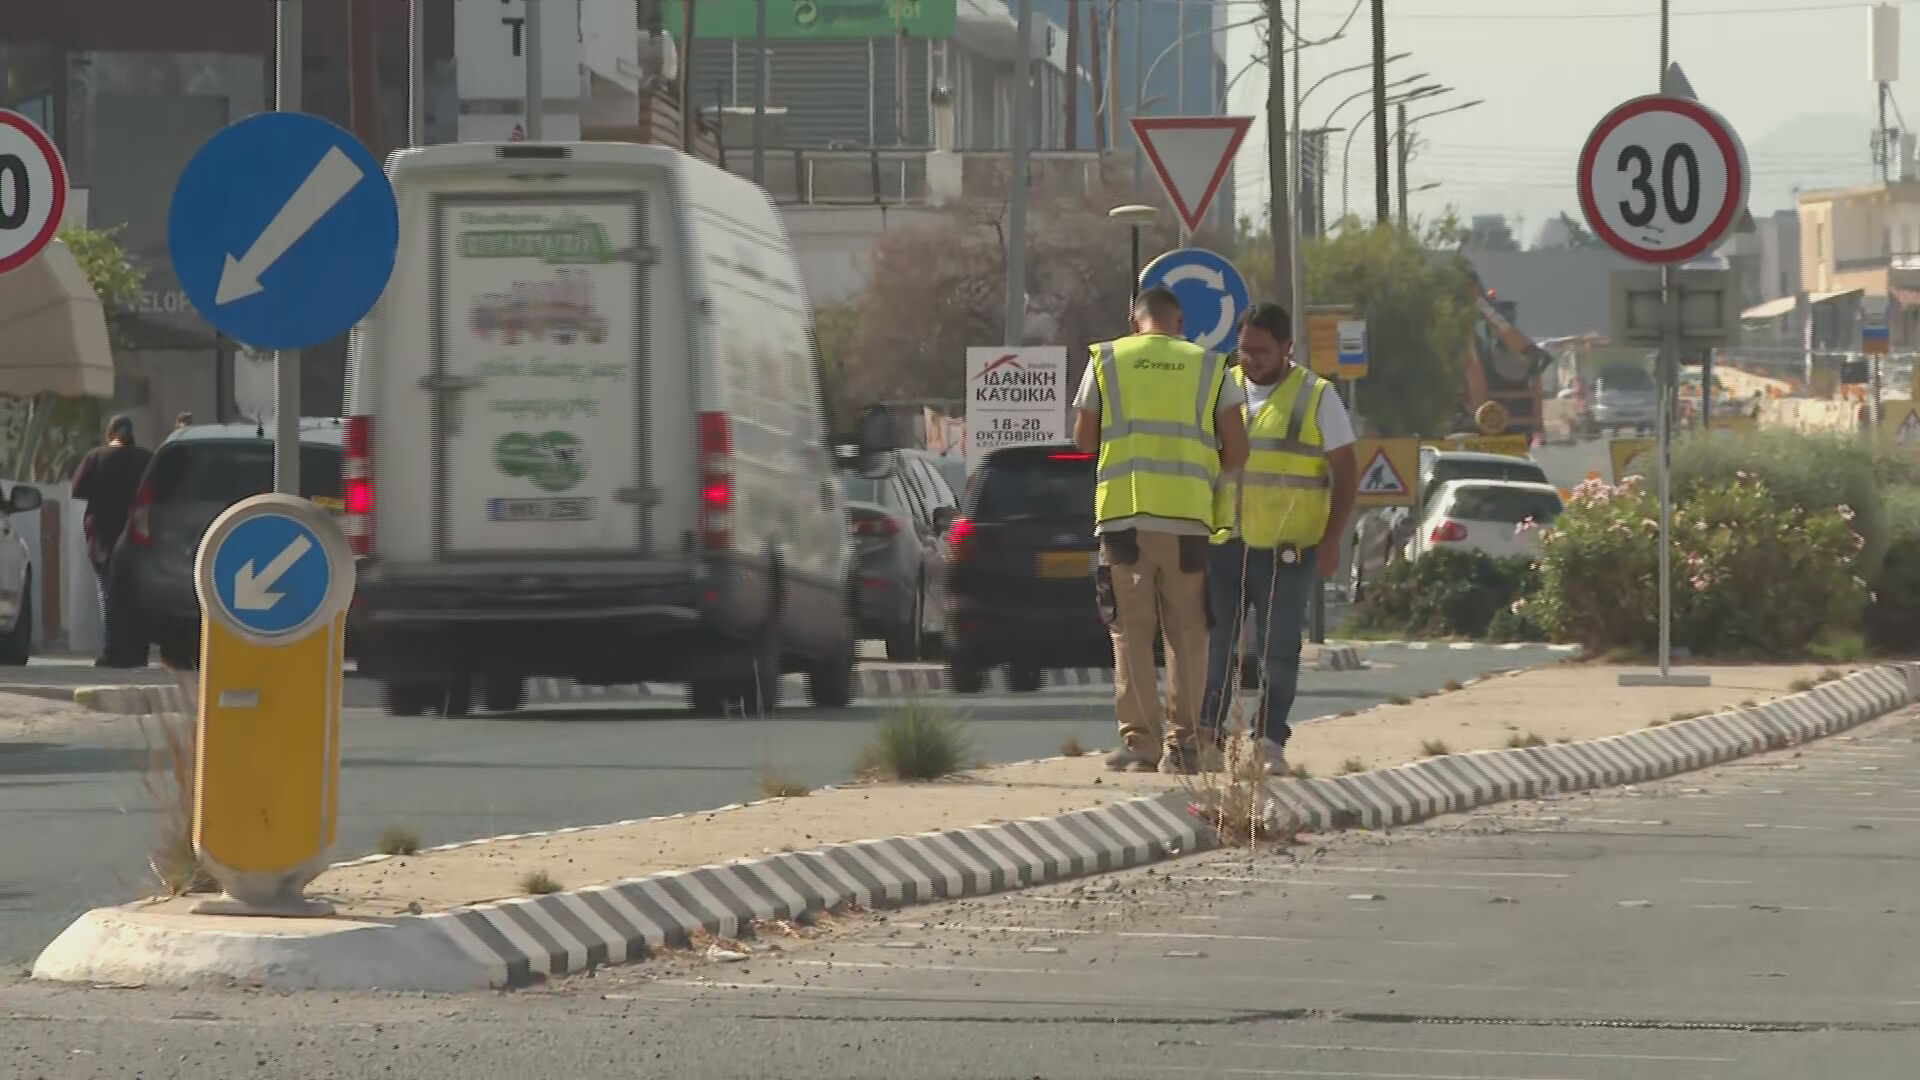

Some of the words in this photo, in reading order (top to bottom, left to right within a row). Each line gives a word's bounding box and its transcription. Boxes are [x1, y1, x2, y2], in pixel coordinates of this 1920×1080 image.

[1617, 142, 1700, 228] 30
[983, 371, 1057, 387] ΙΔΑΝΙΚΗ
[976, 388, 1057, 403] ΚΑΤΟΙΚΙΑ
